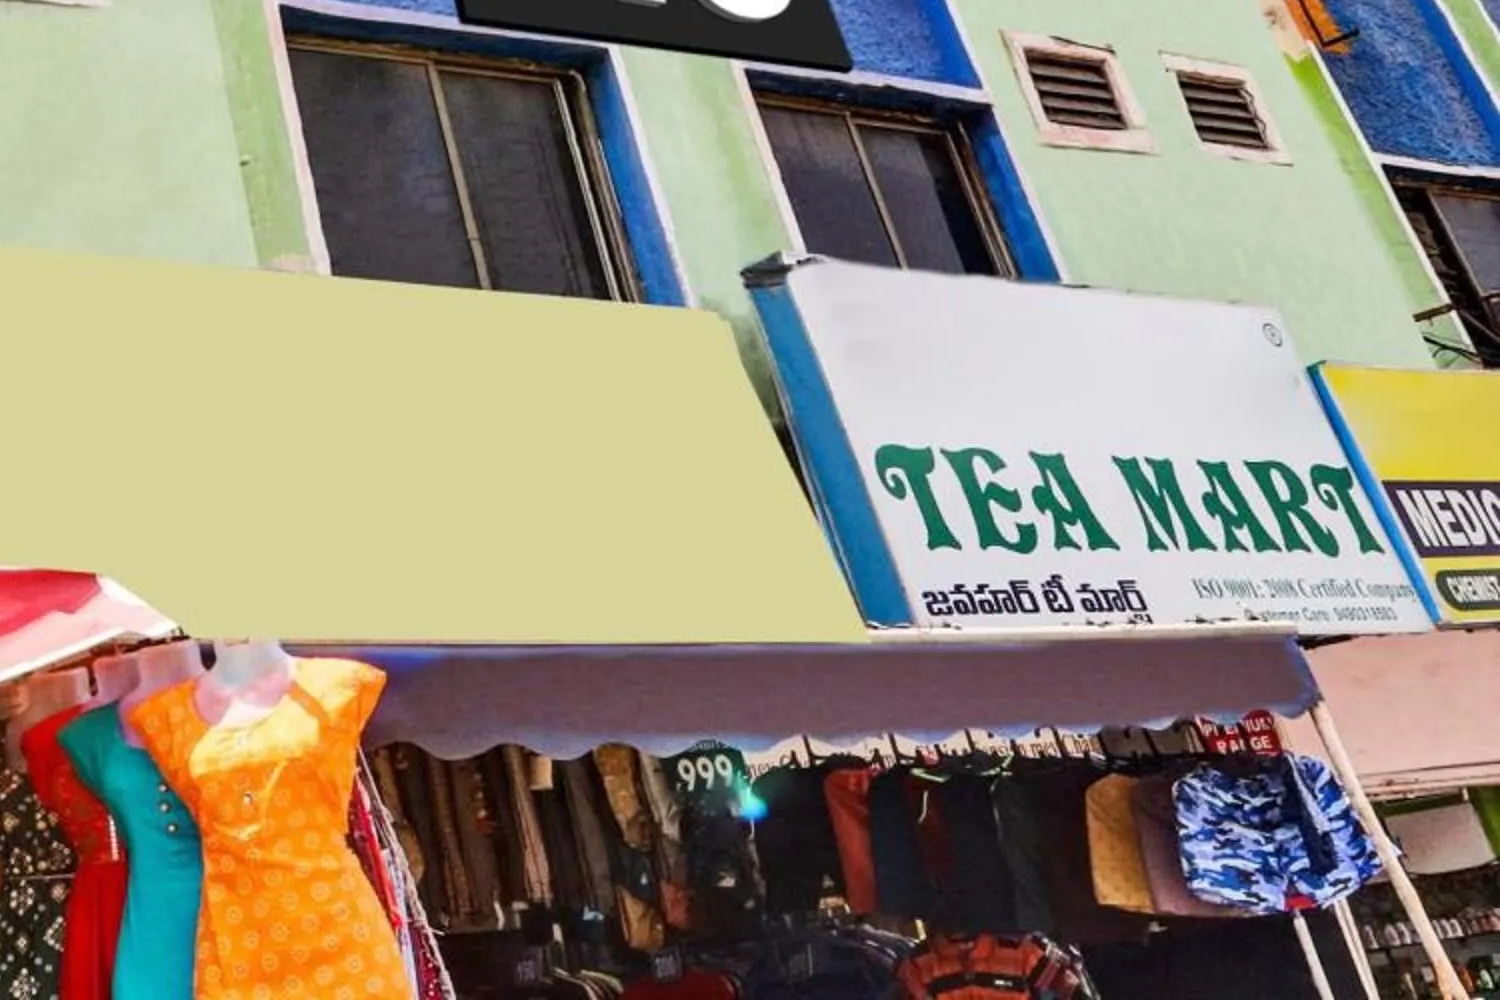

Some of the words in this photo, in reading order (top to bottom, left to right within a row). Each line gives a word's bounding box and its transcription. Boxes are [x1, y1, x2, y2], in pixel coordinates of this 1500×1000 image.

[875, 443, 1119, 554] TEA
[1112, 455, 1386, 557] MART
[1191, 577, 1224, 599] ISO
[677, 754, 733, 792] 999
